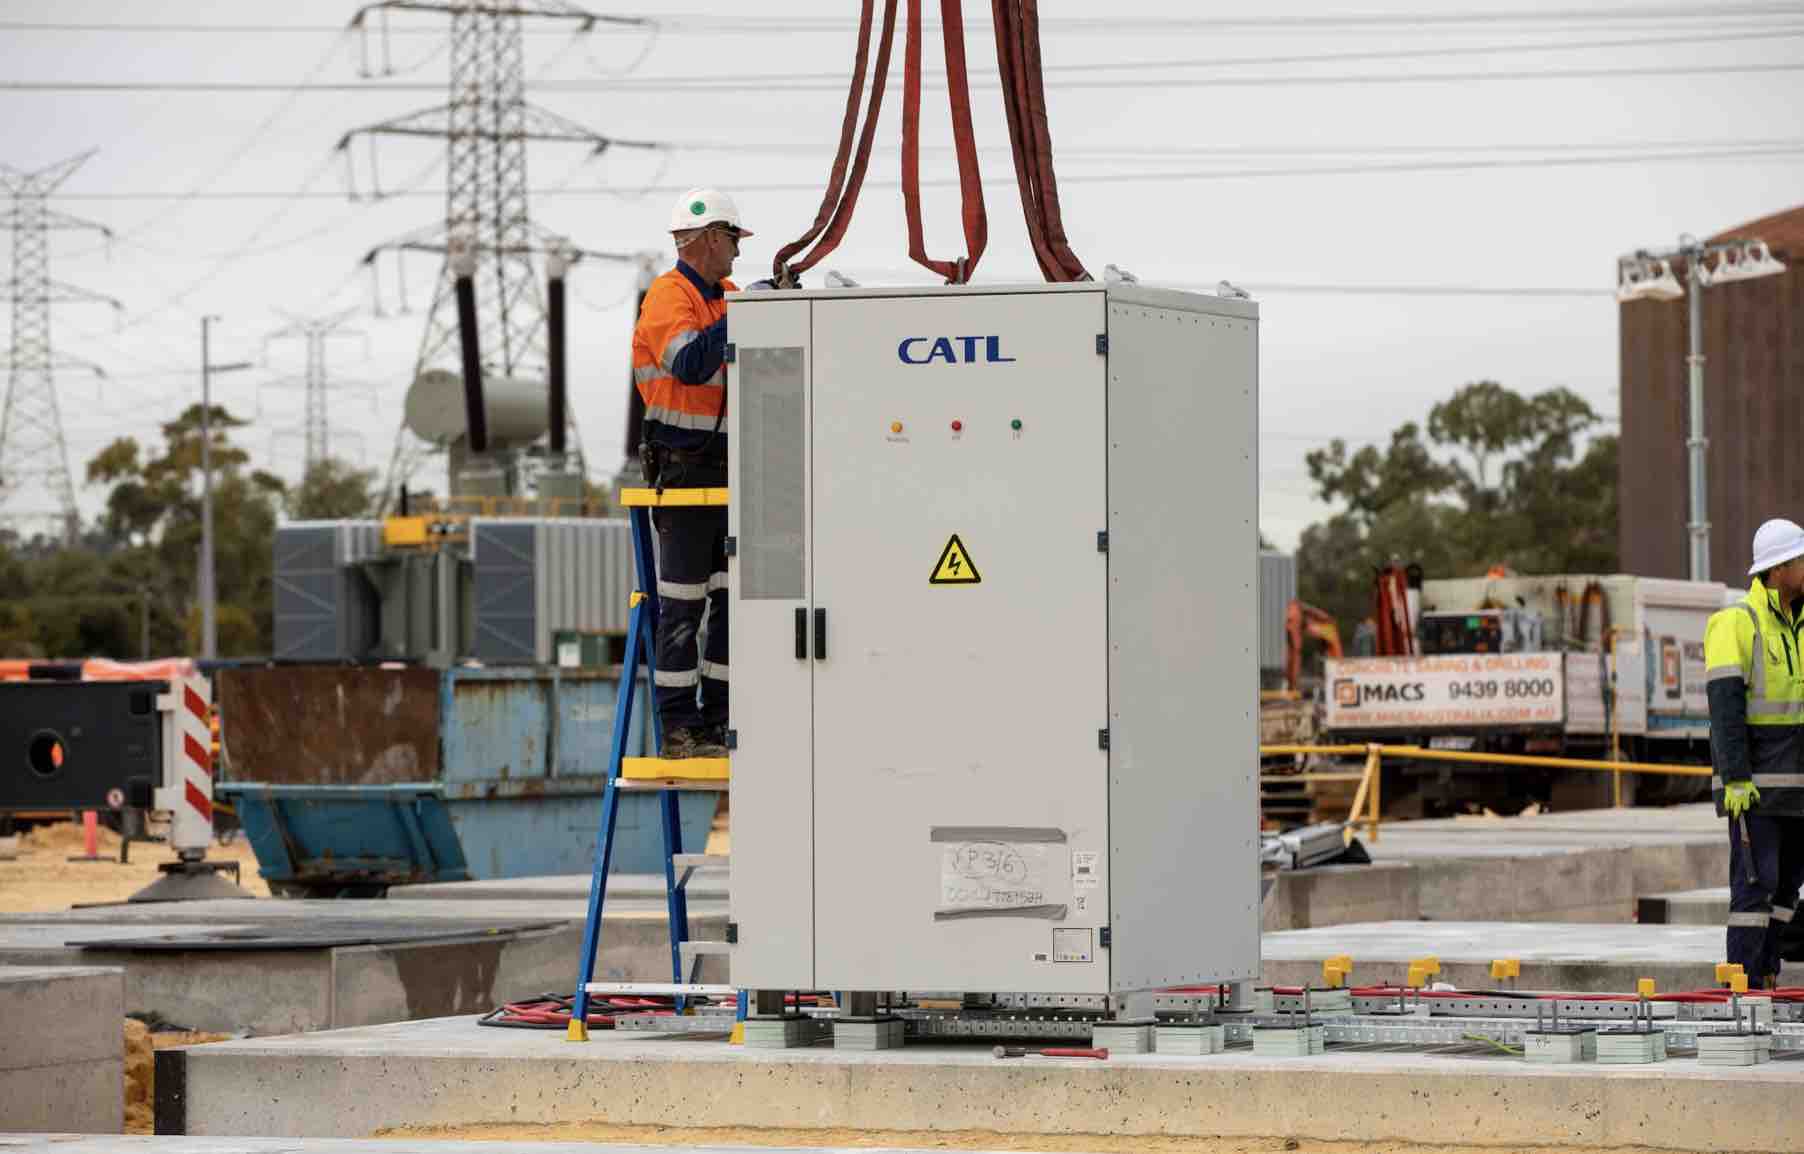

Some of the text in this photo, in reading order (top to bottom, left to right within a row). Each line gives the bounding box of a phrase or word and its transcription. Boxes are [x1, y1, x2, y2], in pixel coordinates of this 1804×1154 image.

[898, 336, 1016, 364] CATL
[1363, 678, 1555, 702] MACS 9439 8000
